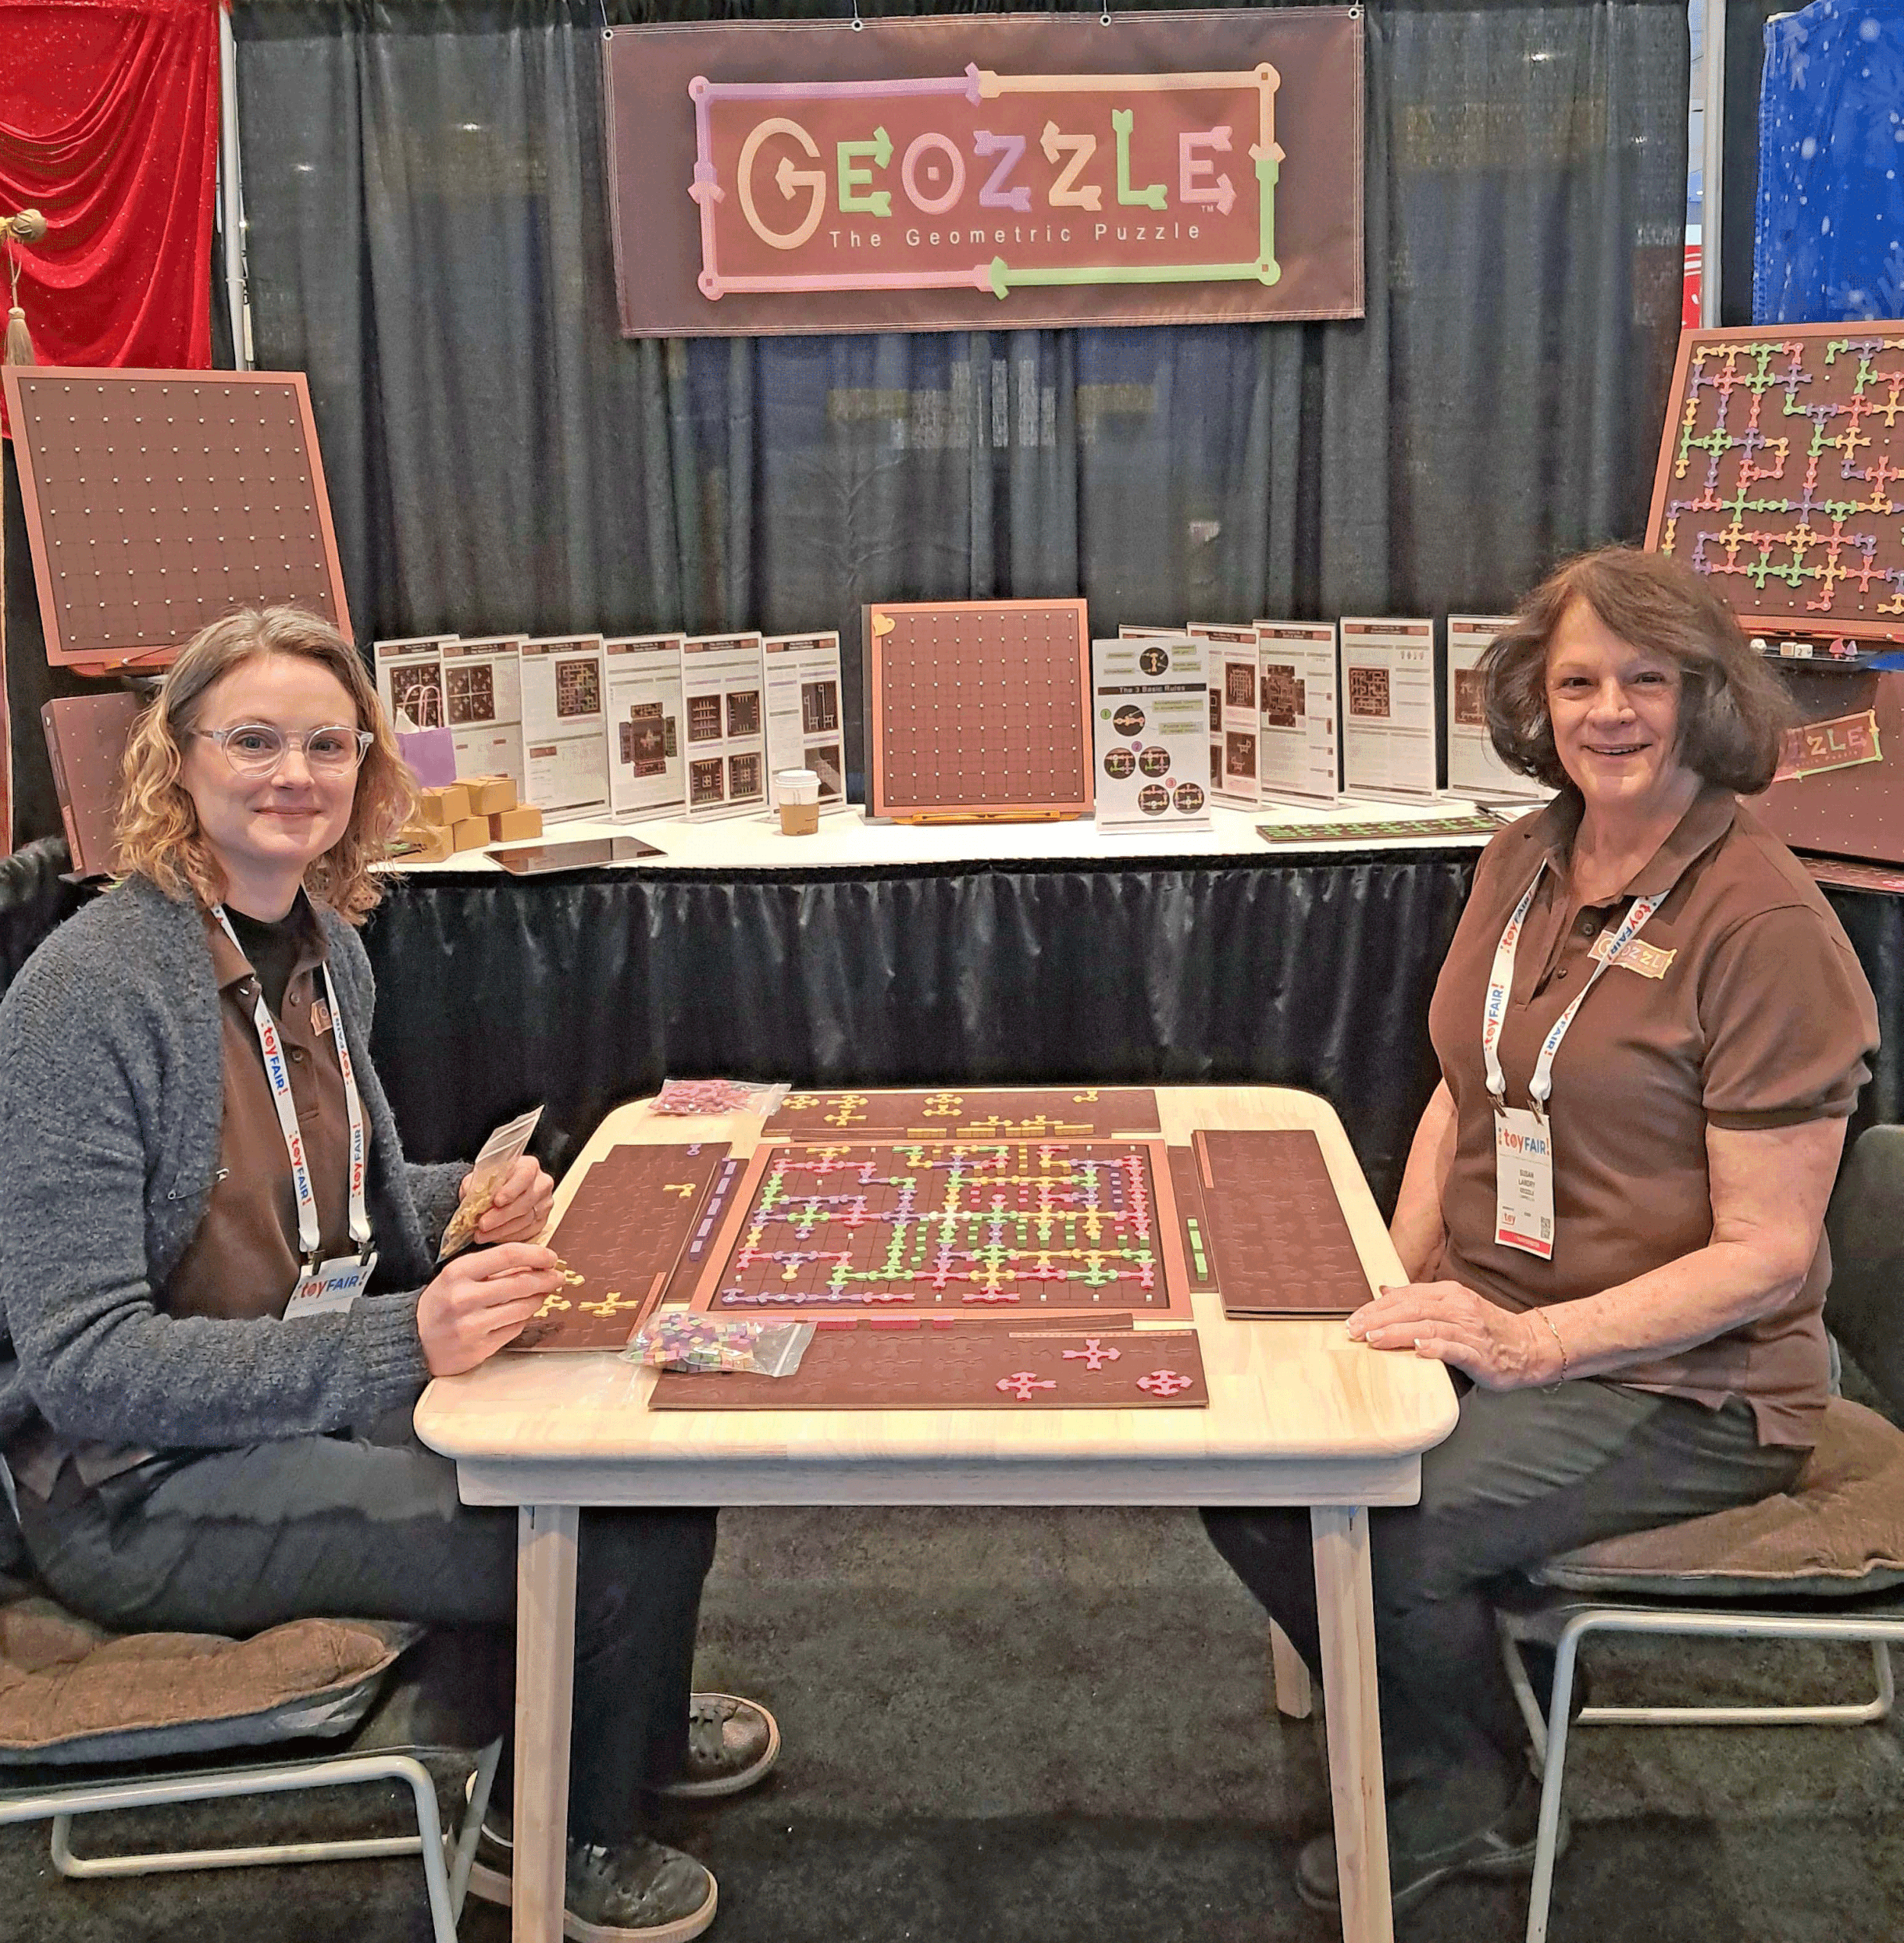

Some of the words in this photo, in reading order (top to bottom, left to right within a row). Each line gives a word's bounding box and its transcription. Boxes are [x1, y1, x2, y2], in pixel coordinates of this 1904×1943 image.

[737, 109, 1237, 250] GEOZZLE
[829, 231, 882, 248] The
[906, 225, 1071, 247] Geometric
[1095, 222, 1200, 241] Puzzle
[1485, 983, 1505, 1044] toyFAIR!
[264, 1027, 289, 1095] toyFAIR!
[292, 1138, 311, 1206] toyFAIR!
[352, 1123, 361, 1190] toyFAIR!
[1504, 1128, 1550, 1155] toyFAIR!
[301, 1270, 368, 1299] toyFAIR!
